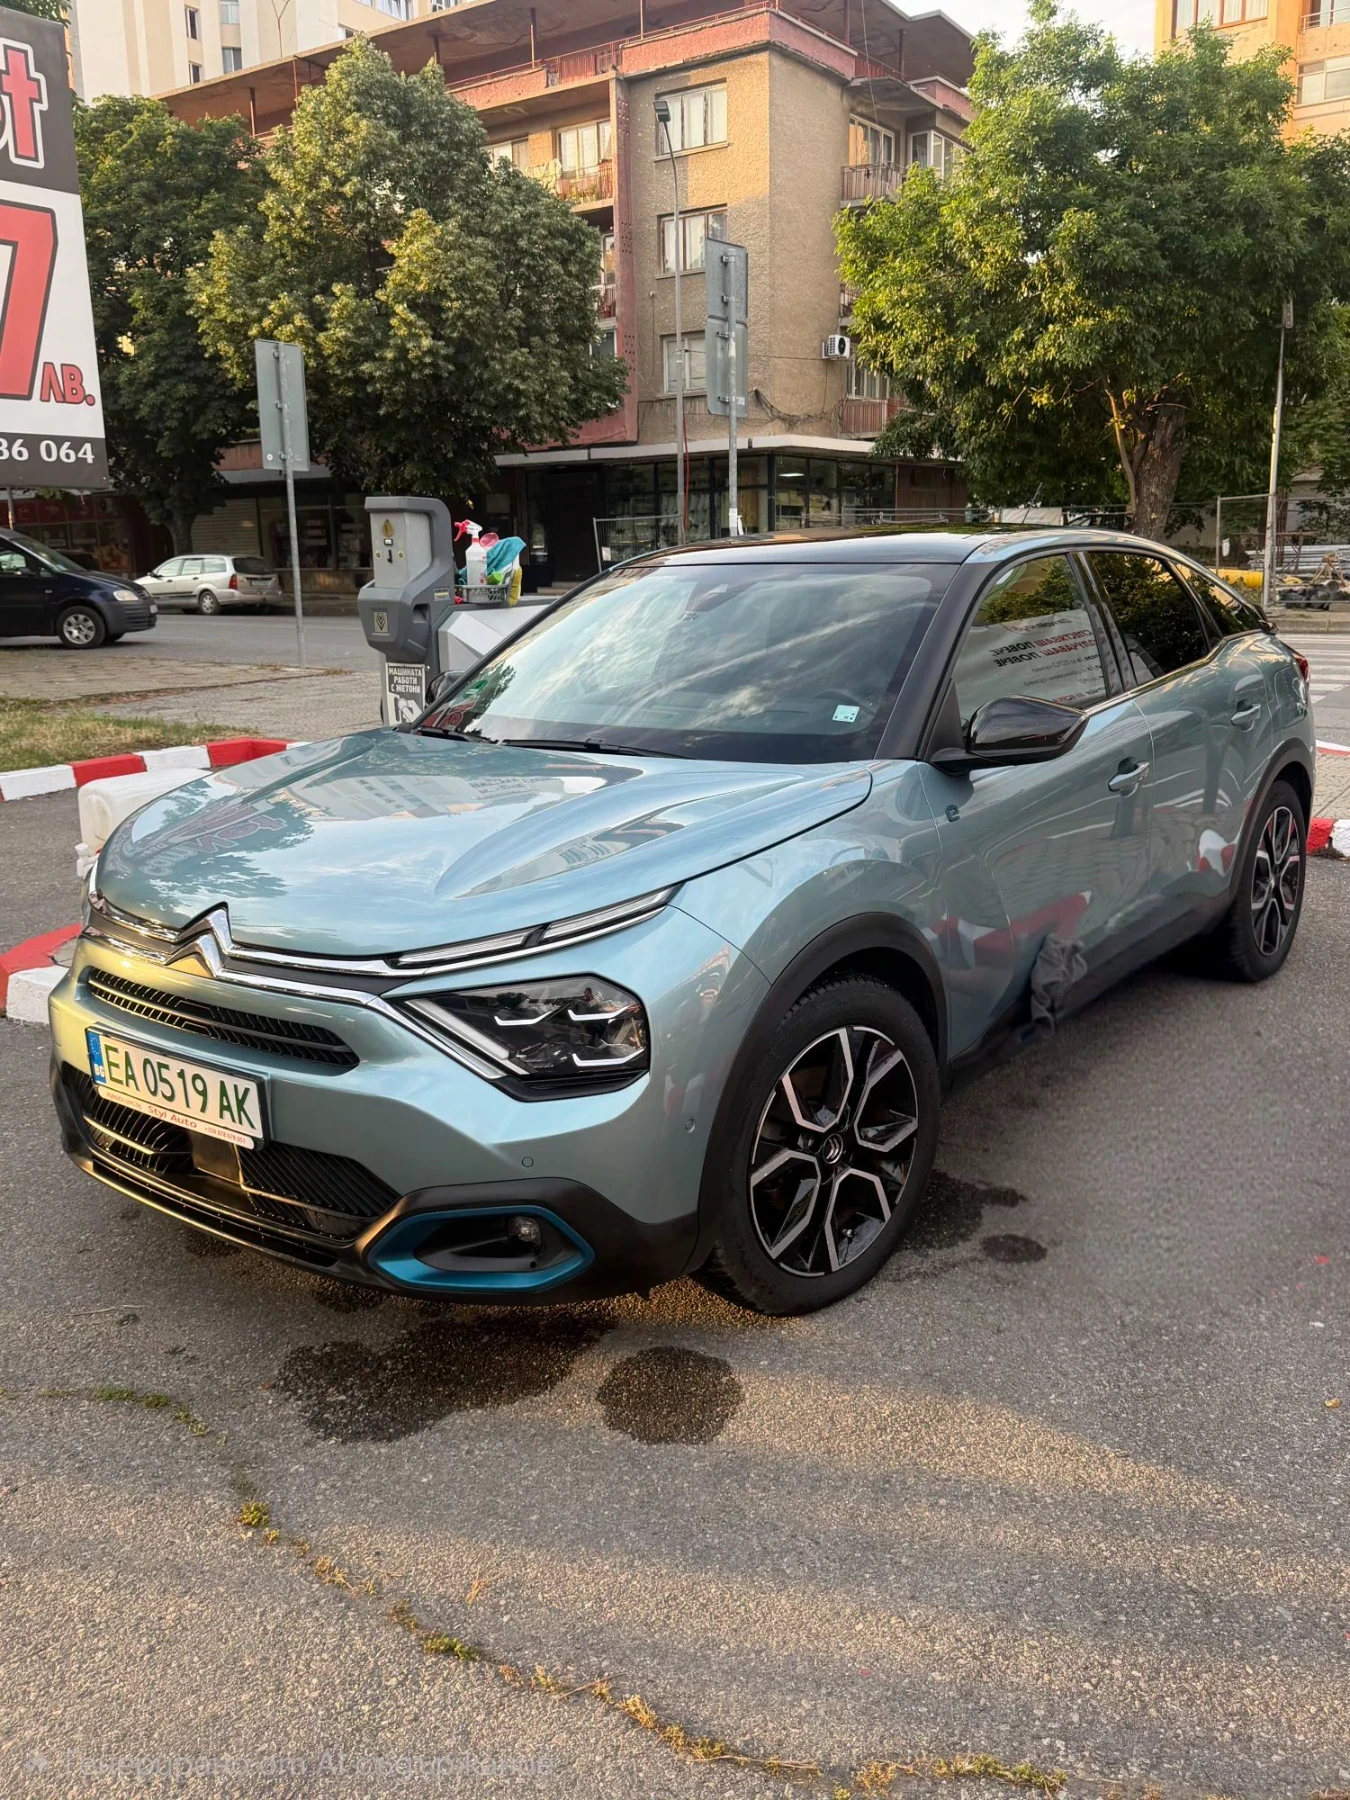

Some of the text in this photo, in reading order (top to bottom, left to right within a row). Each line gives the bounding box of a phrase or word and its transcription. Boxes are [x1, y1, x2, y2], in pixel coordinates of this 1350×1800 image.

[40, 440, 95, 463] 064
[388, 667, 422, 677] МАШИНАТА
[393, 675, 418, 685] РАБОТИ
[94, 1063, 105, 1077] BG
[219, 1080, 257, 1130] AK
[147, 1105, 167, 1119] Styl
[171, 1114, 198, 1129] Auto
